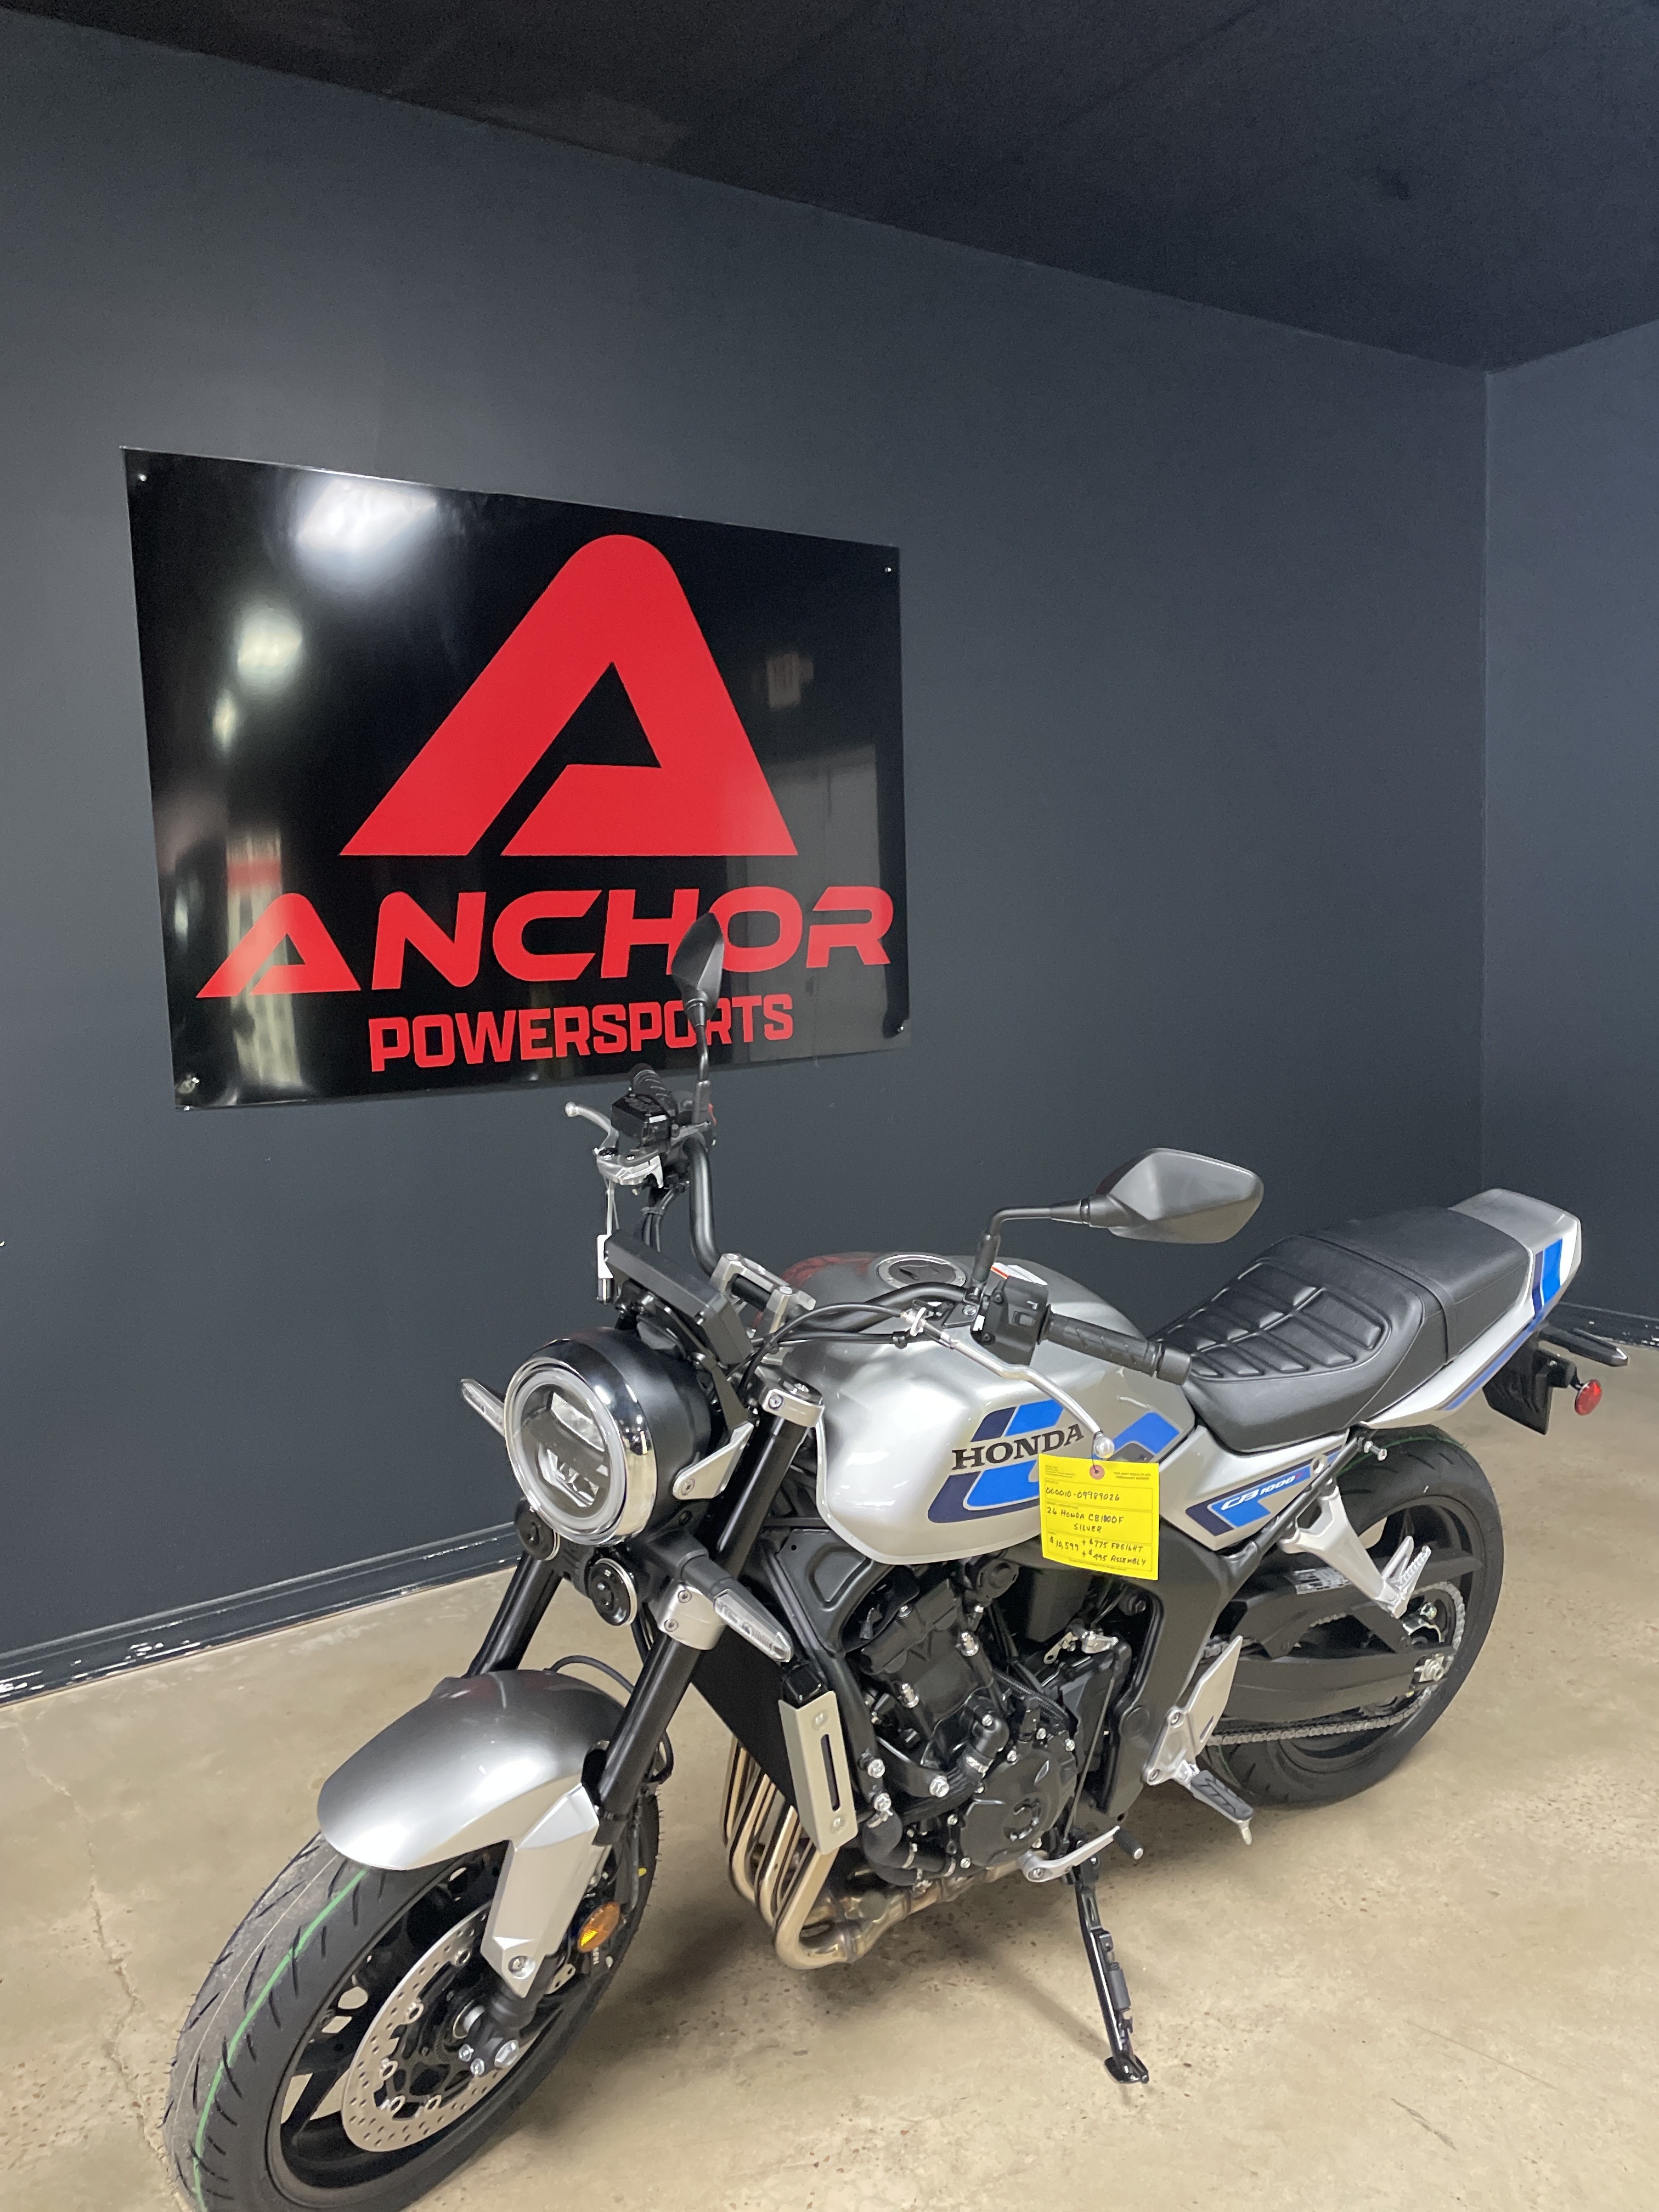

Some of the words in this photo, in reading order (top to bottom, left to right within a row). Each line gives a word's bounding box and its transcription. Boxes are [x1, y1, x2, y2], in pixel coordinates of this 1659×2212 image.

[196, 886, 894, 998] ANCHOR
[368, 994, 793, 1072] POWERSPORTS
[952, 1424, 1084, 1470] HONDA
[1046, 1506, 1057, 1515] 26
[1074, 1523, 1102, 1533] SILVER
[1111, 1542, 1144, 1553] FREIGHT
[1110, 1555, 1147, 1566] ASSEMBLY
